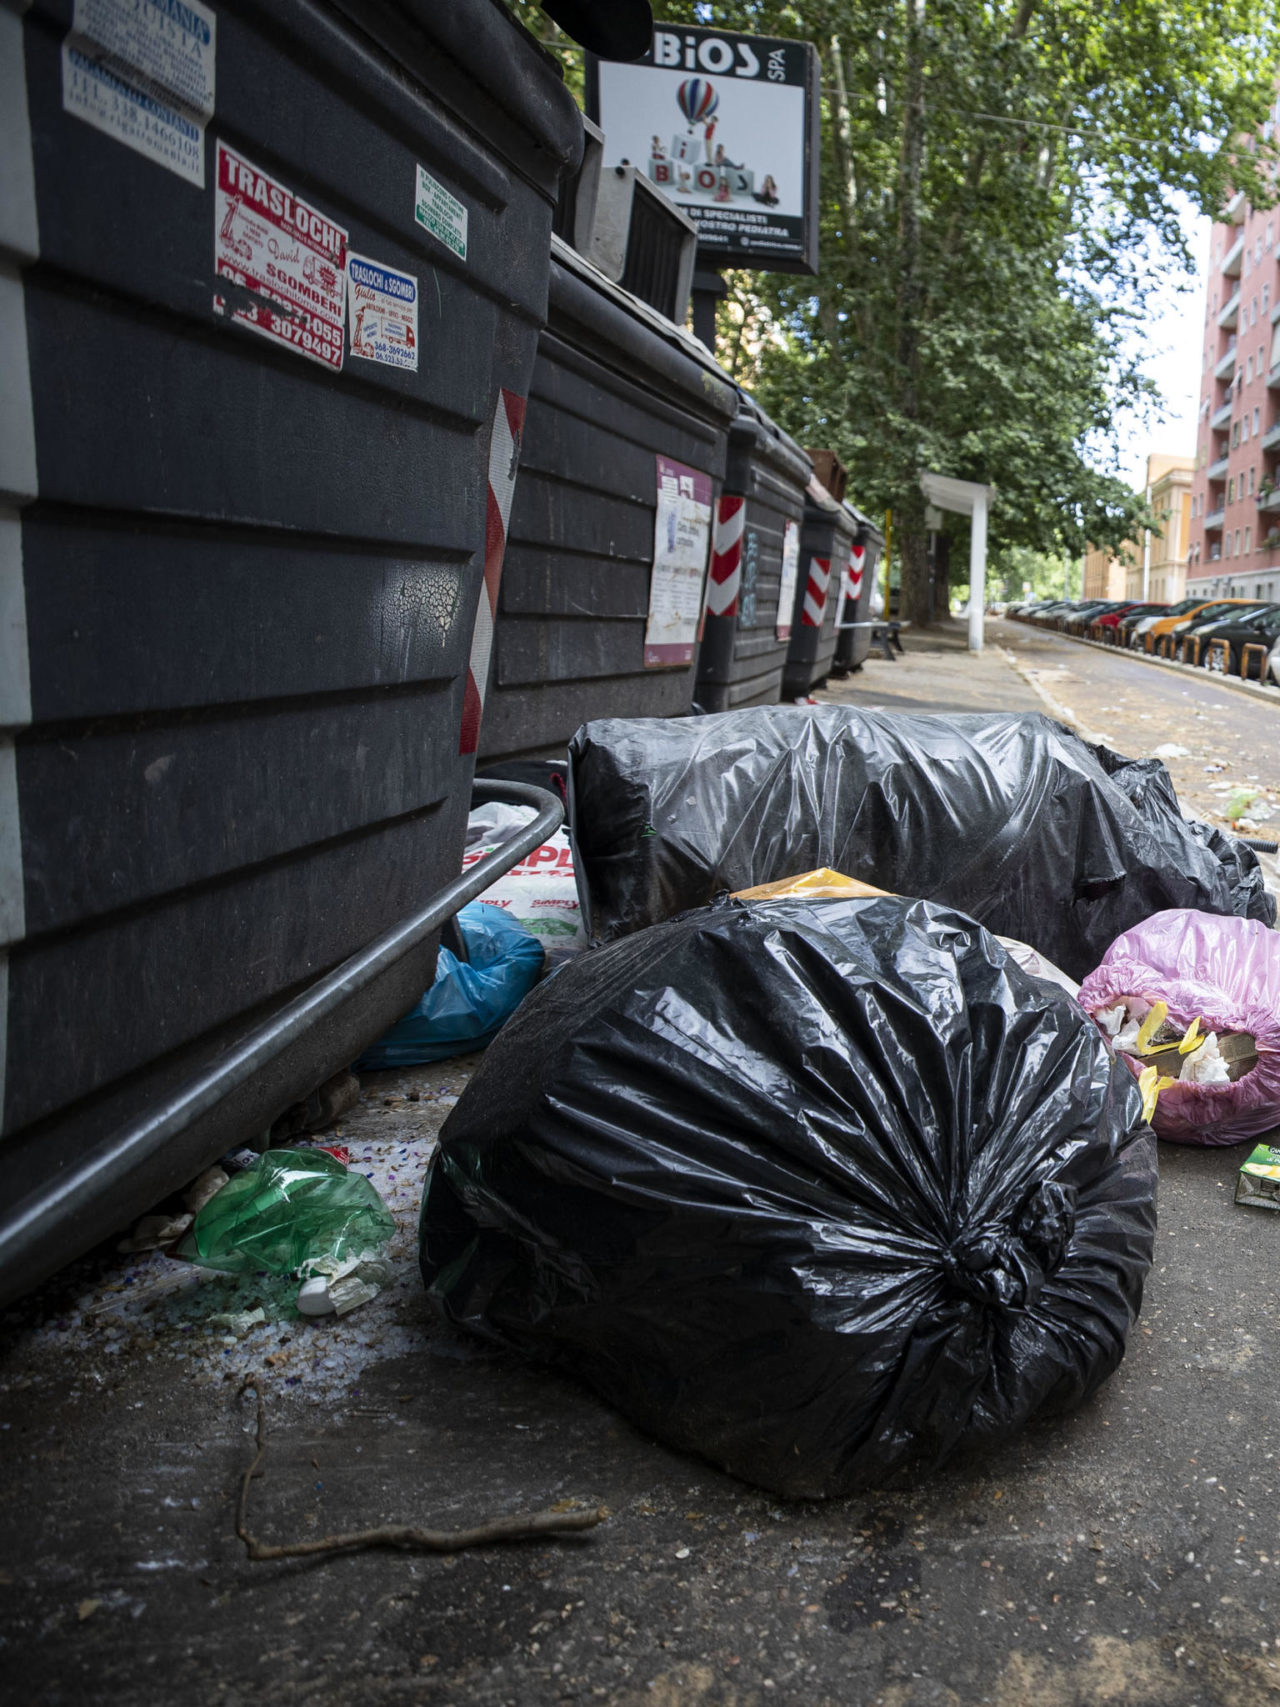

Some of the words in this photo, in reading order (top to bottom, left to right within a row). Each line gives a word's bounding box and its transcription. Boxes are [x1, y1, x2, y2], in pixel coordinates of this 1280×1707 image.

[768, 48, 786, 81] SPA
[225, 154, 342, 256] TRASLOCHI
[703, 209, 768, 225] SPECIALISTI
[738, 224, 790, 237] PEDIATRA
[267, 228, 299, 272] David
[266, 262, 341, 317] SGOMBERI
[351, 262, 383, 288] TRASLOCHI
[388, 276, 413, 299] SGOMBRI
[354, 282, 376, 301] Giulio
[270, 313, 340, 364] 3079497
